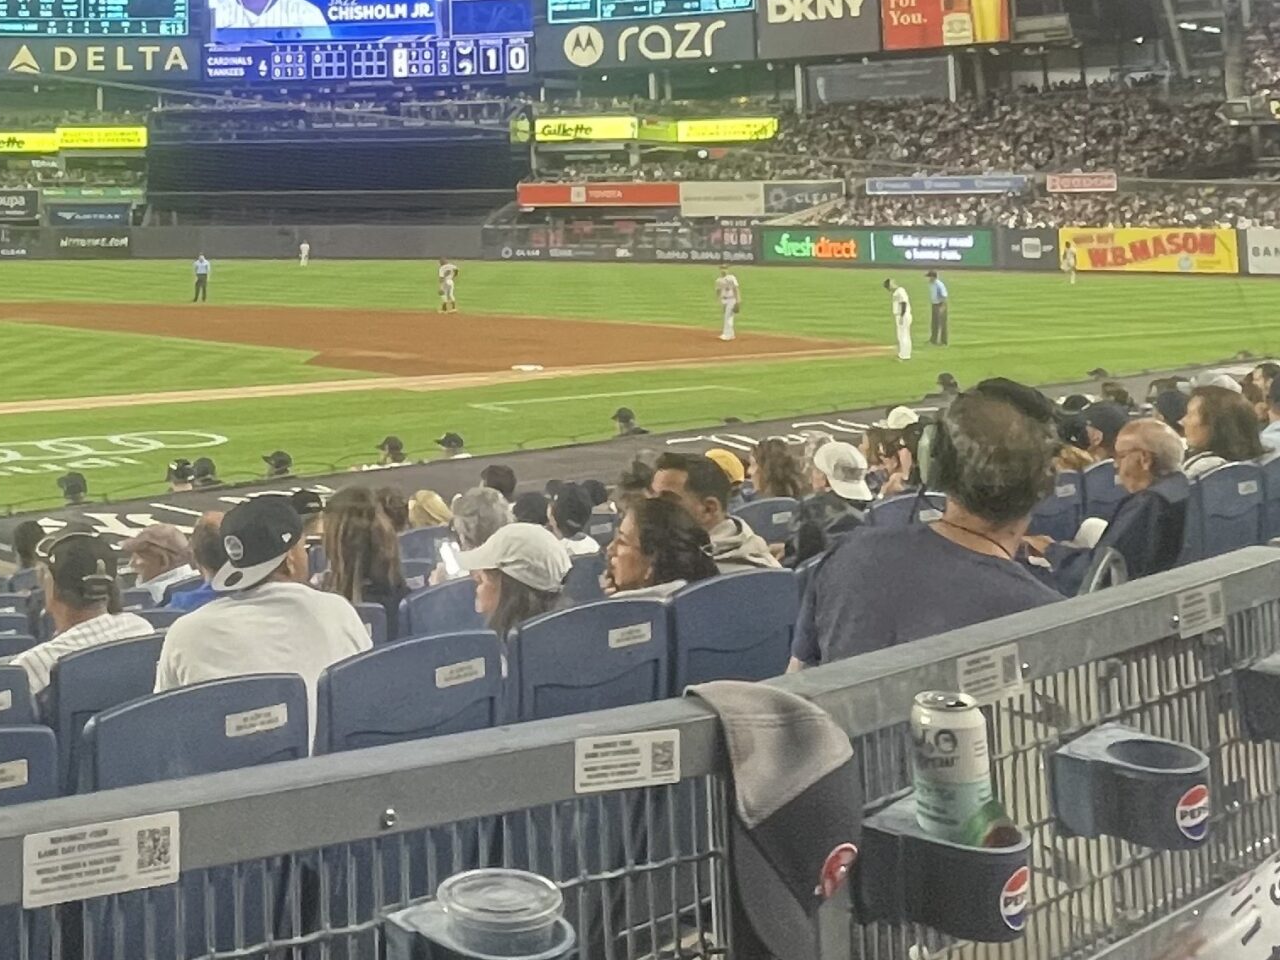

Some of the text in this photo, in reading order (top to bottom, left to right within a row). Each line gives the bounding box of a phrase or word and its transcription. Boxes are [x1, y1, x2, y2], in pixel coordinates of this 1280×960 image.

[327, 2, 435, 21] CHISHOLM JR.
[888, 9, 928, 26] You.
[619, 20, 726, 61] razr
[54, 45, 188, 72] DELTA
[207, 56, 253, 66] CARDINALS
[486, 48, 497, 71] 1
[510, 47, 525, 70] 0
[541, 124, 593, 137] Gillette
[775, 233, 857, 260] freshdirect
[921, 235, 948, 249] every
[1129, 232, 1216, 262] MASON
